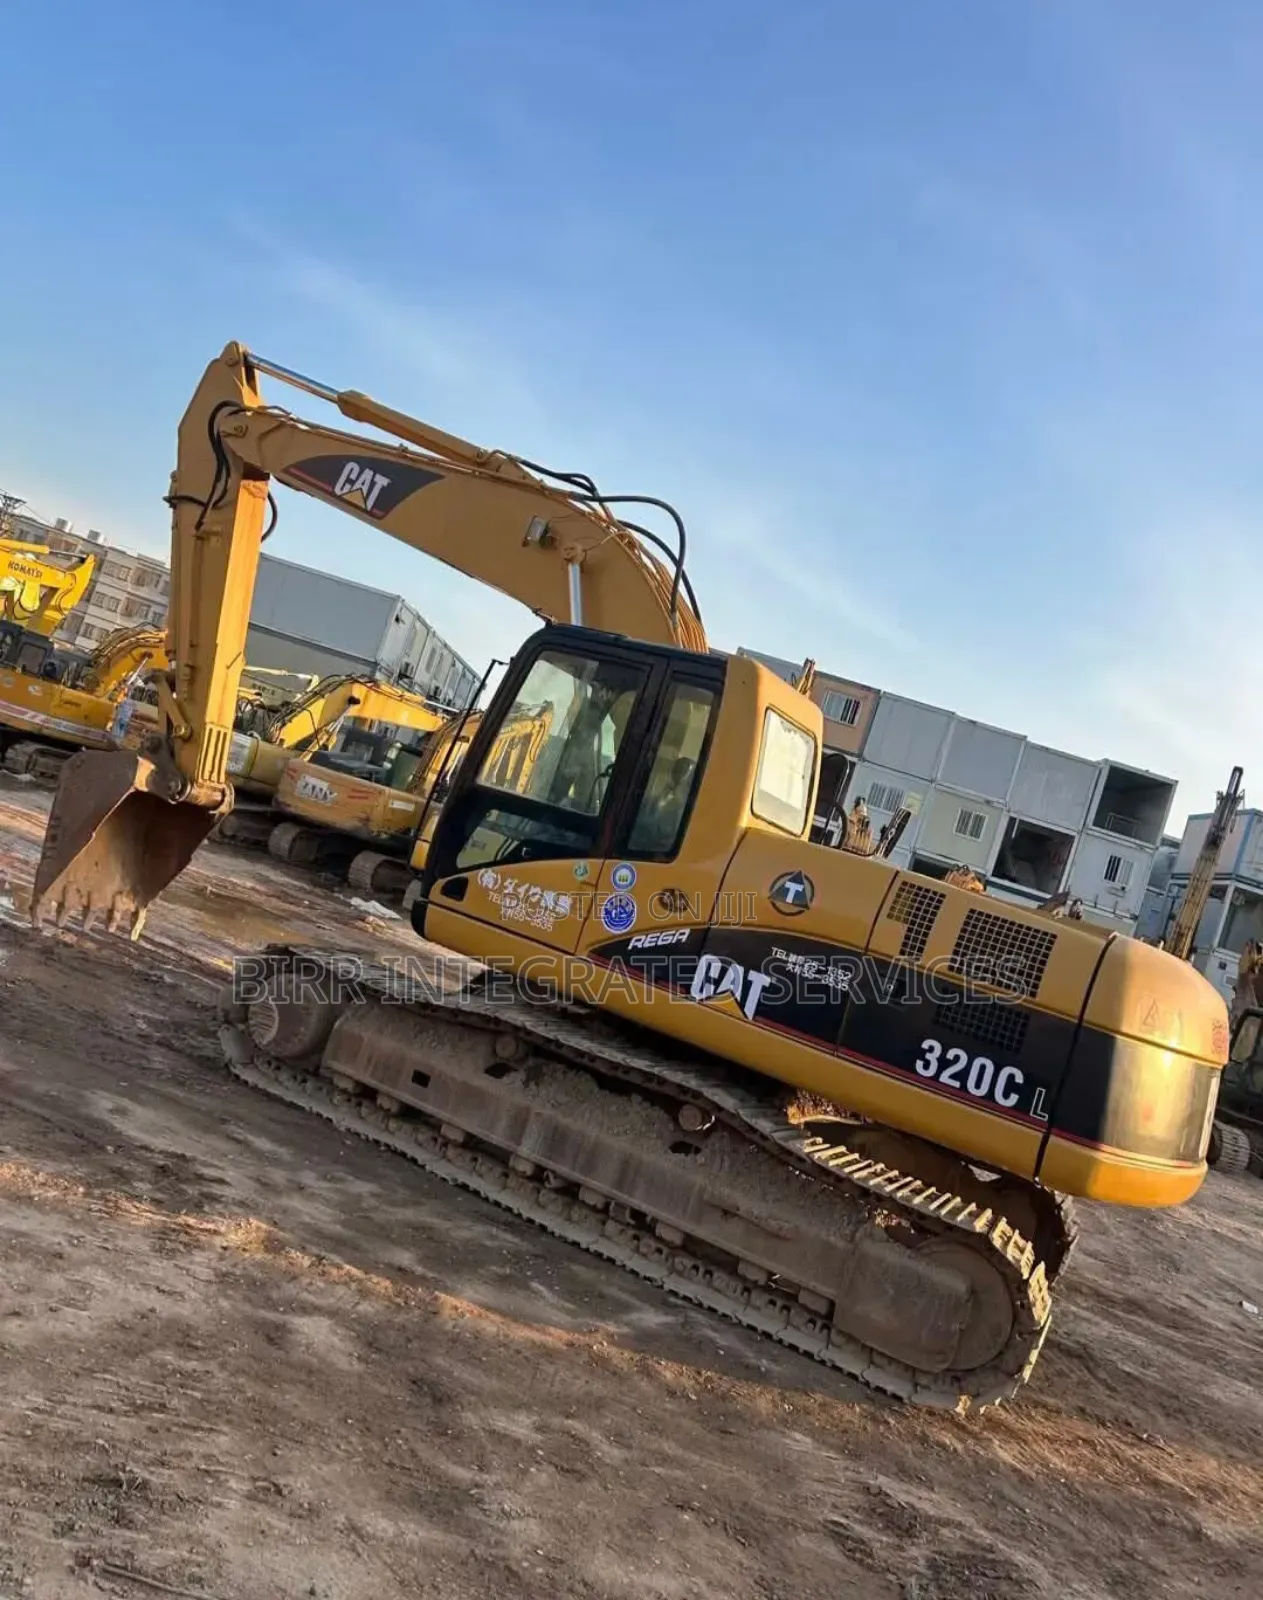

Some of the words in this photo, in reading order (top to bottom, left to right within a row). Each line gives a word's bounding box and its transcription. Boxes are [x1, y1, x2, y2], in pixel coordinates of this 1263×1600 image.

[334, 461, 392, 511] CAT
[628, 928, 691, 950] REGA
[690, 954, 771, 1021] CAT
[915, 1038, 1024, 1107] 320C
[1029, 1087, 1049, 1121] L
